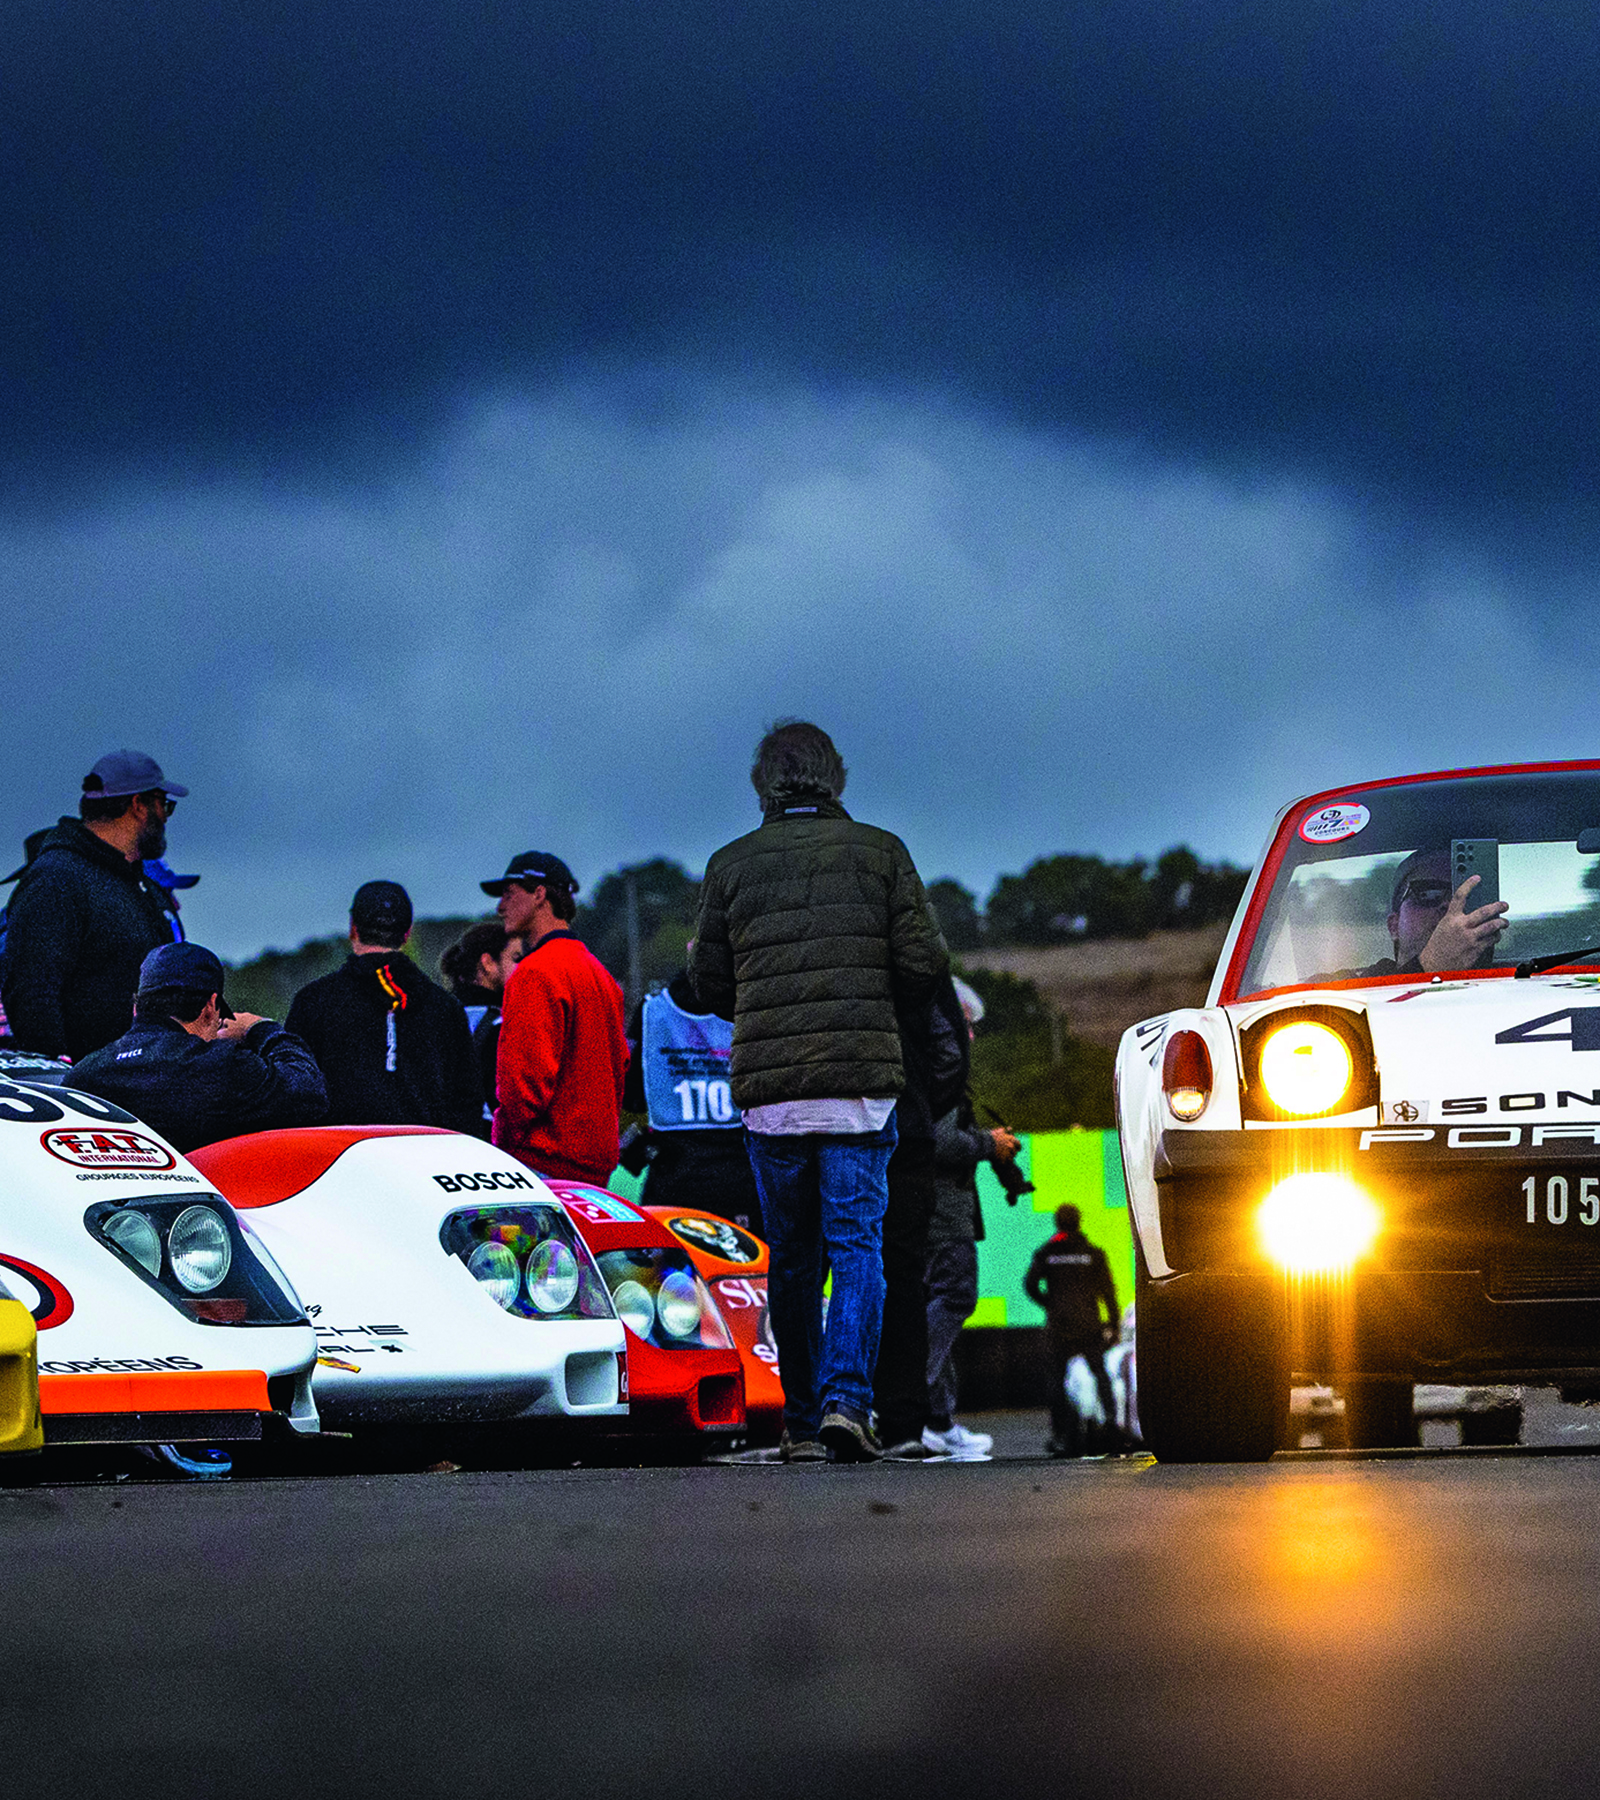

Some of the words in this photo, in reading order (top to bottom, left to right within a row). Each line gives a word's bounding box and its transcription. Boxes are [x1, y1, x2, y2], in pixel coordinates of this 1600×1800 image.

[673, 1079, 733, 1121] 170
[78, 1154, 162, 1164] INTERNATIONAL
[432, 1172, 534, 1194] BOSCH
[1522, 1176, 1600, 1226] 105
